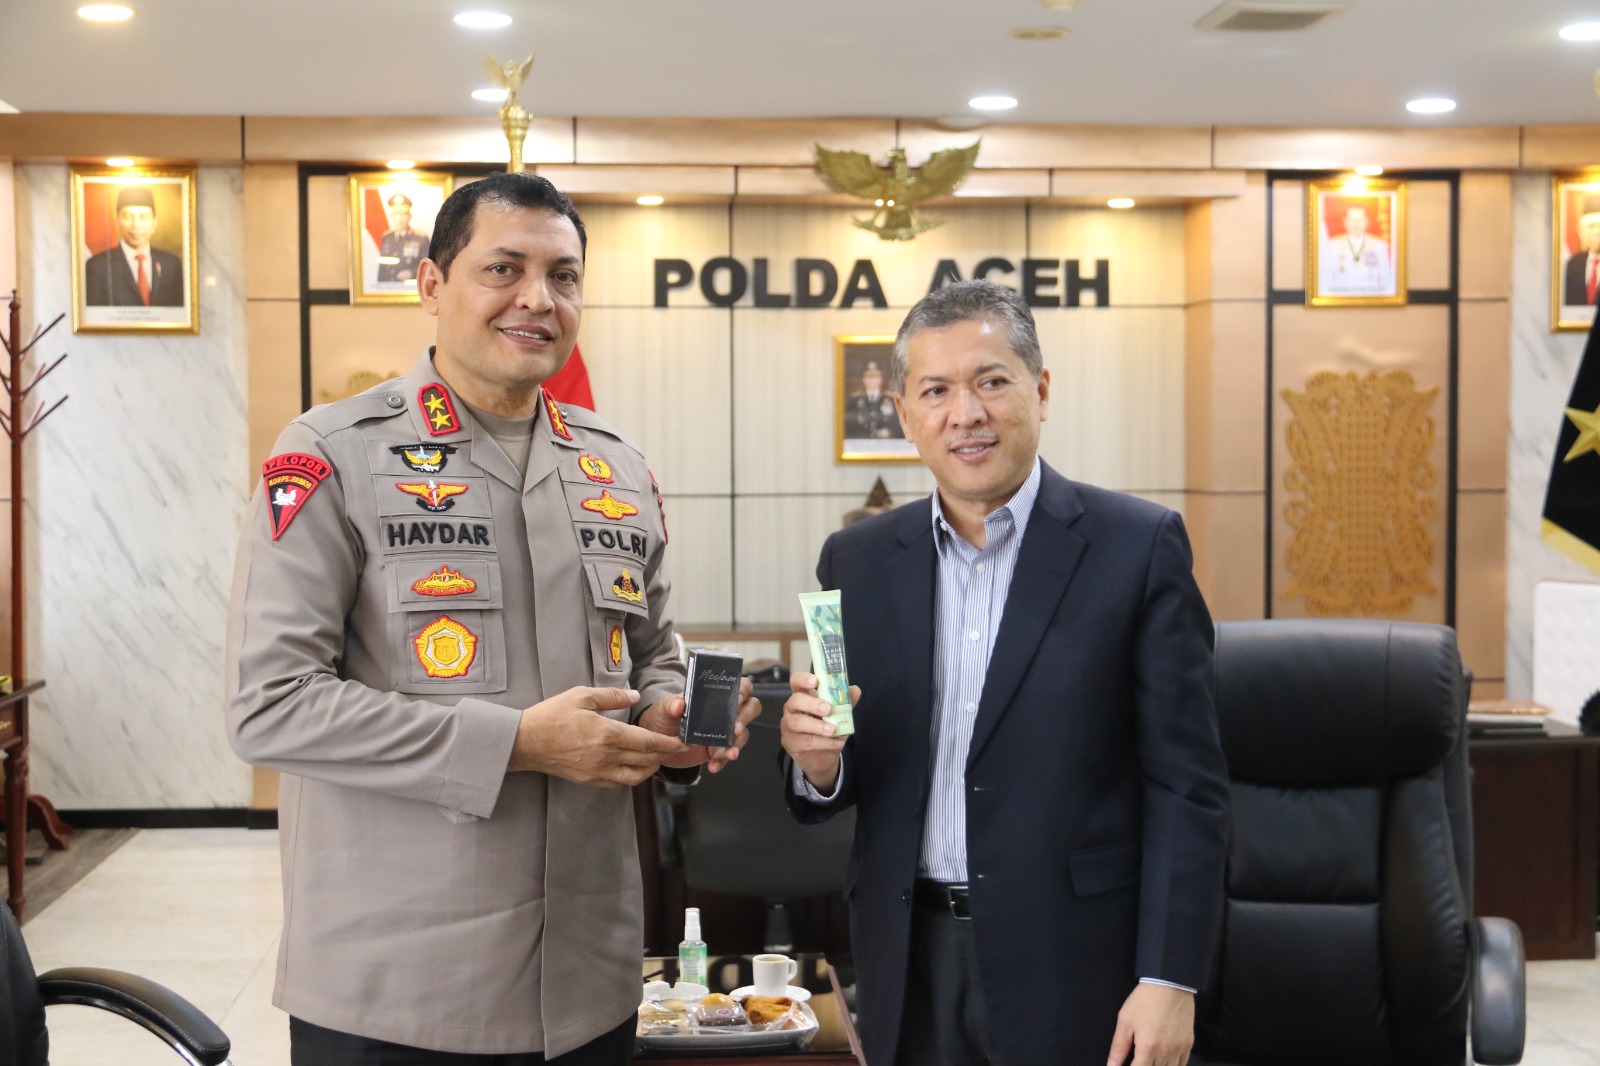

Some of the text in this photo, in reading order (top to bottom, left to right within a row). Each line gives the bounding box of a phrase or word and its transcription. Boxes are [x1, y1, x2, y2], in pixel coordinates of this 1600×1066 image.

[654, 257, 889, 308] POLDA
[269, 455, 323, 474] PELOPOR
[268, 475, 289, 487] KORPS
[388, 522, 490, 547] HAYDAR
[580, 528, 647, 558] POLRI
